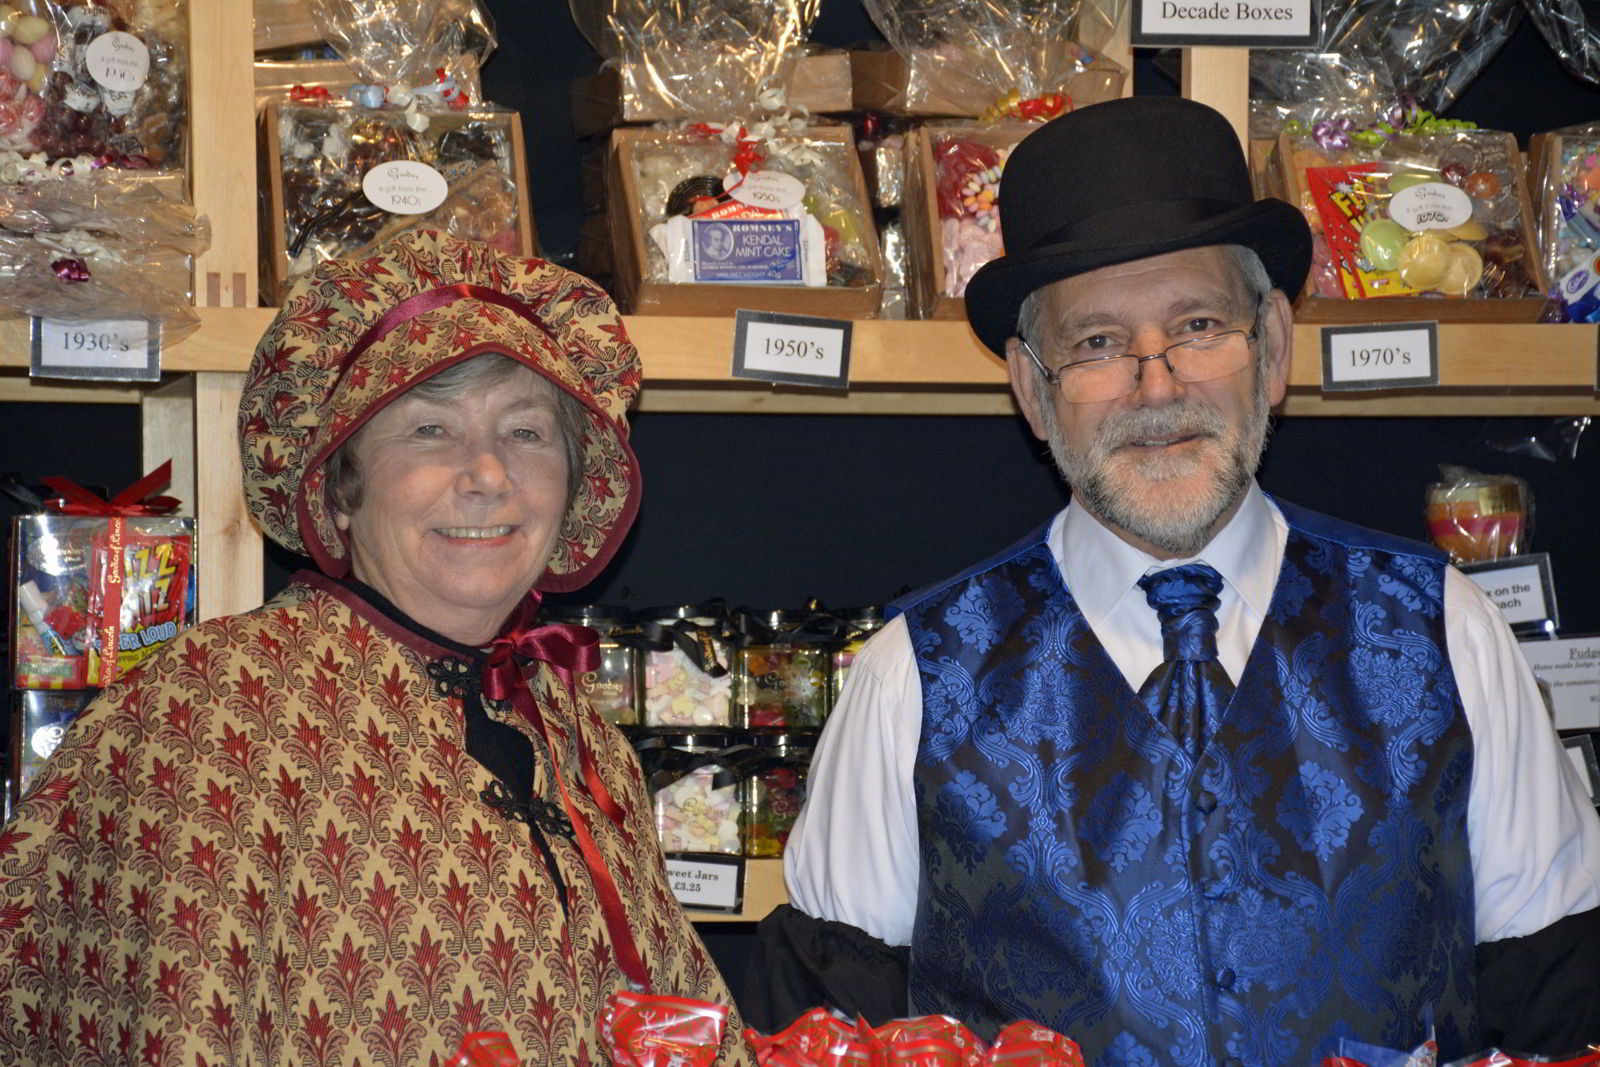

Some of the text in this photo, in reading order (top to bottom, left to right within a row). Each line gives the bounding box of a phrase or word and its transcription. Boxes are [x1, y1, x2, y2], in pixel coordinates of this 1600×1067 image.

[1162, 2, 1293, 21] Decade Boxes
[752, 192, 781, 203] 1950s
[733, 224, 793, 232] ROMNEY'S
[743, 234, 783, 246] KENDAL
[735, 247, 762, 257] MINT
[764, 246, 792, 257] CAKE
[767, 270, 781, 279] 40g
[64, 332, 129, 352] 1930's
[765, 338, 824, 360] 1950's
[1350, 347, 1411, 368] 1970's
[1495, 587, 1509, 596] on
[1512, 583, 1531, 594] the
[140, 621, 177, 643] LOUD
[102, 625, 115, 655] Lincoln
[581, 672, 624, 694] Goodies
[666, 869, 719, 881] weet Jars
[673, 881, 701, 893] £3.25
